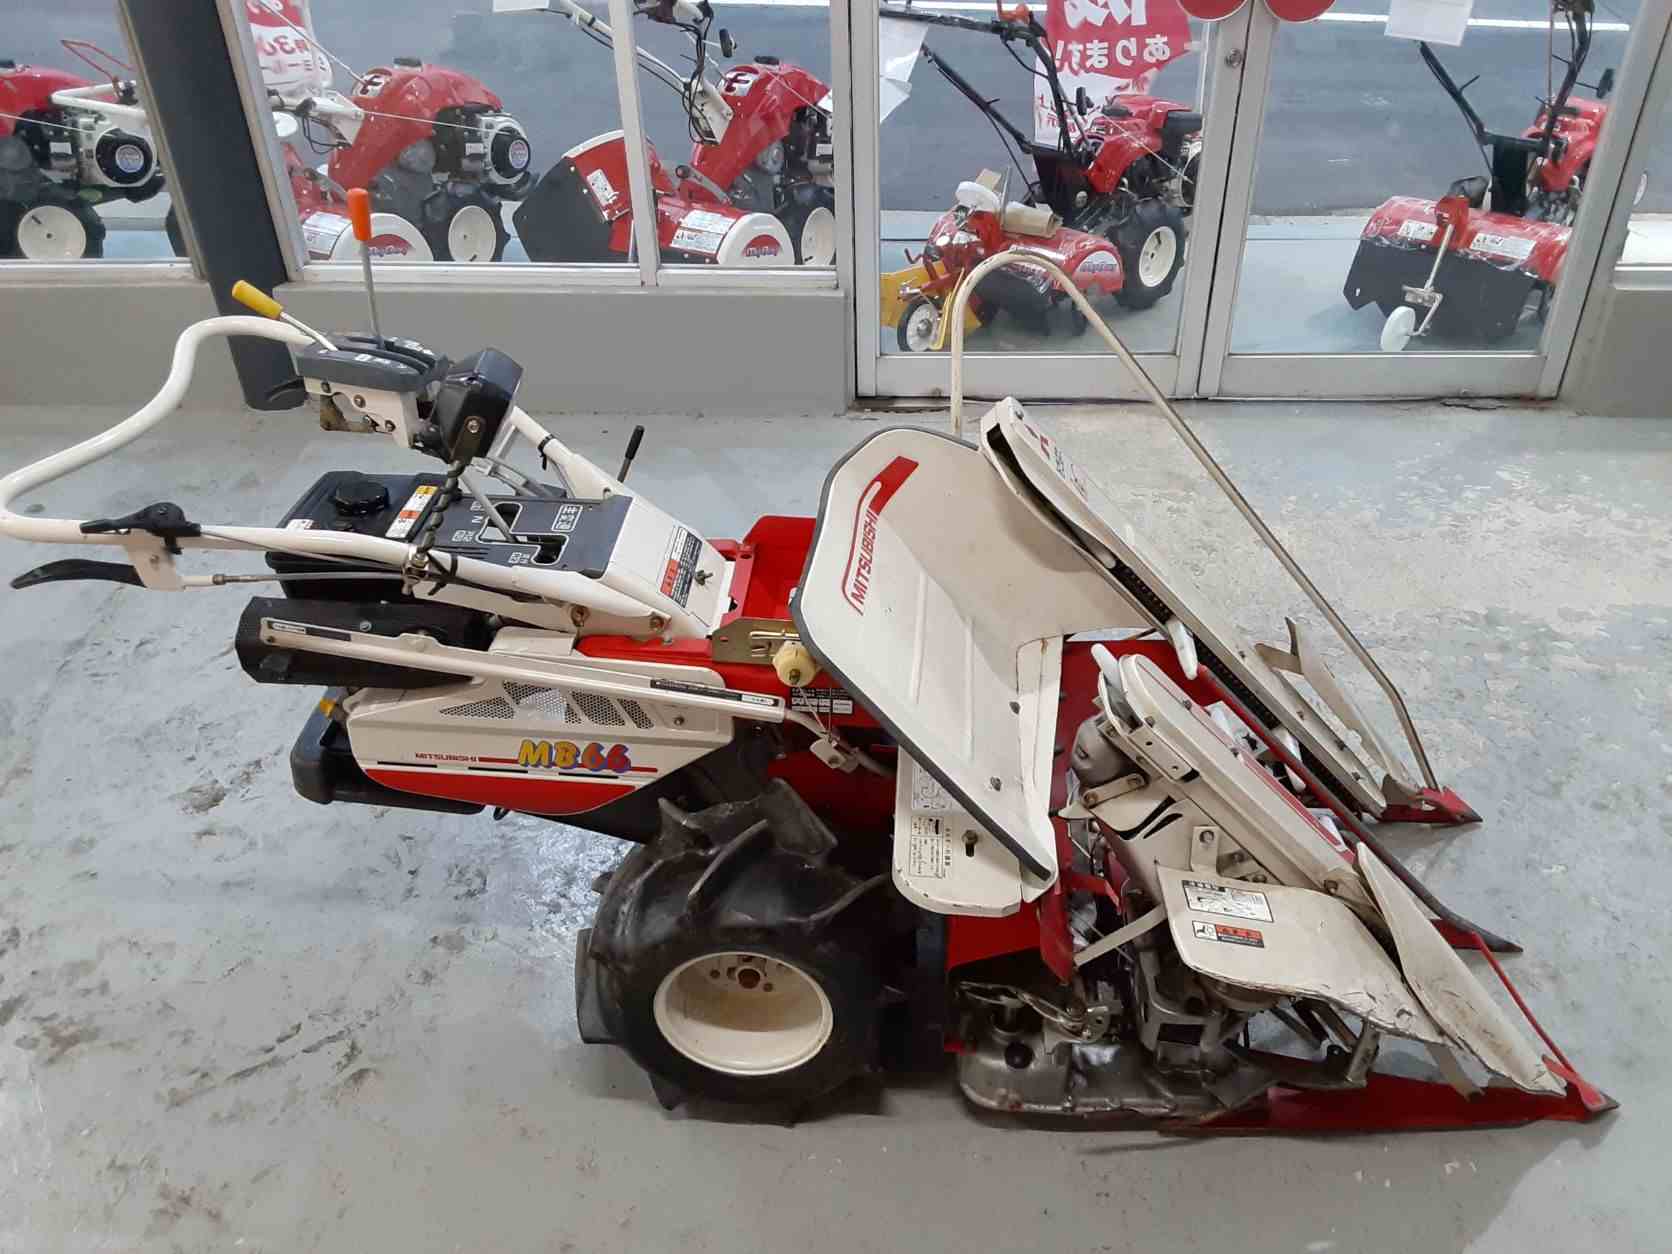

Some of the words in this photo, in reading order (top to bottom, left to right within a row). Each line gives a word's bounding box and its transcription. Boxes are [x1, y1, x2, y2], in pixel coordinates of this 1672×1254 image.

[851, 509, 879, 606] MITSUBISHI
[415, 752, 477, 762] MITSUBISHI
[518, 739, 632, 773] MB66
